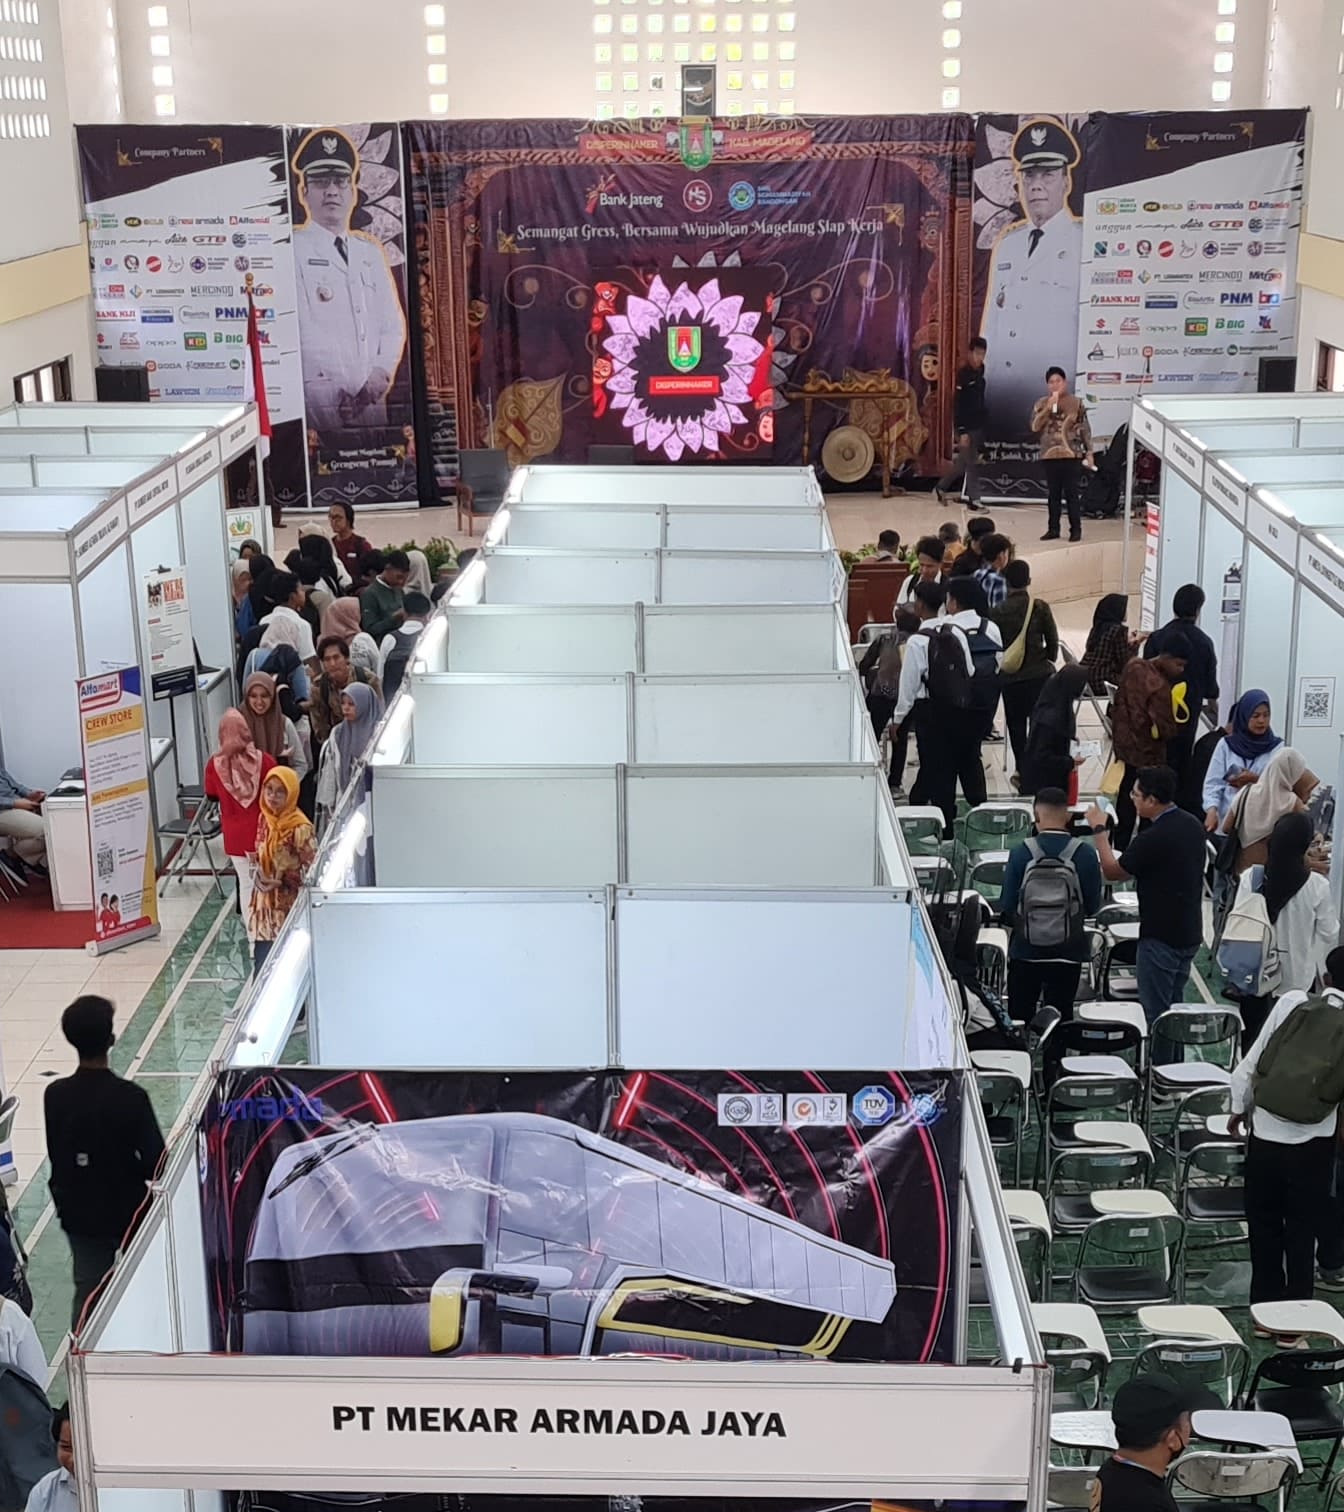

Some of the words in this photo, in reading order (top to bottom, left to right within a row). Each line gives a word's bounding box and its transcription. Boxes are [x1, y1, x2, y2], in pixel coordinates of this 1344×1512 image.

[600, 192, 627, 206] Bank
[517, 223, 578, 240] Semangat
[622, 222, 679, 238] Bersama
[682, 221, 748, 238] Wujudkan
[752, 220, 815, 238] Magelang
[848, 218, 883, 237] Kerja
[1220, 293, 1253, 304] PNM
[215, 308, 248, 318] PNM
[81, 679, 118, 697] Alfamart
[110, 709, 133, 725] STORE
[332, 1405, 373, 1432] PT
[385, 1405, 519, 1434] MEKAR
[529, 1407, 692, 1437] ARMADA
[701, 1409, 787, 1438] JAYA
